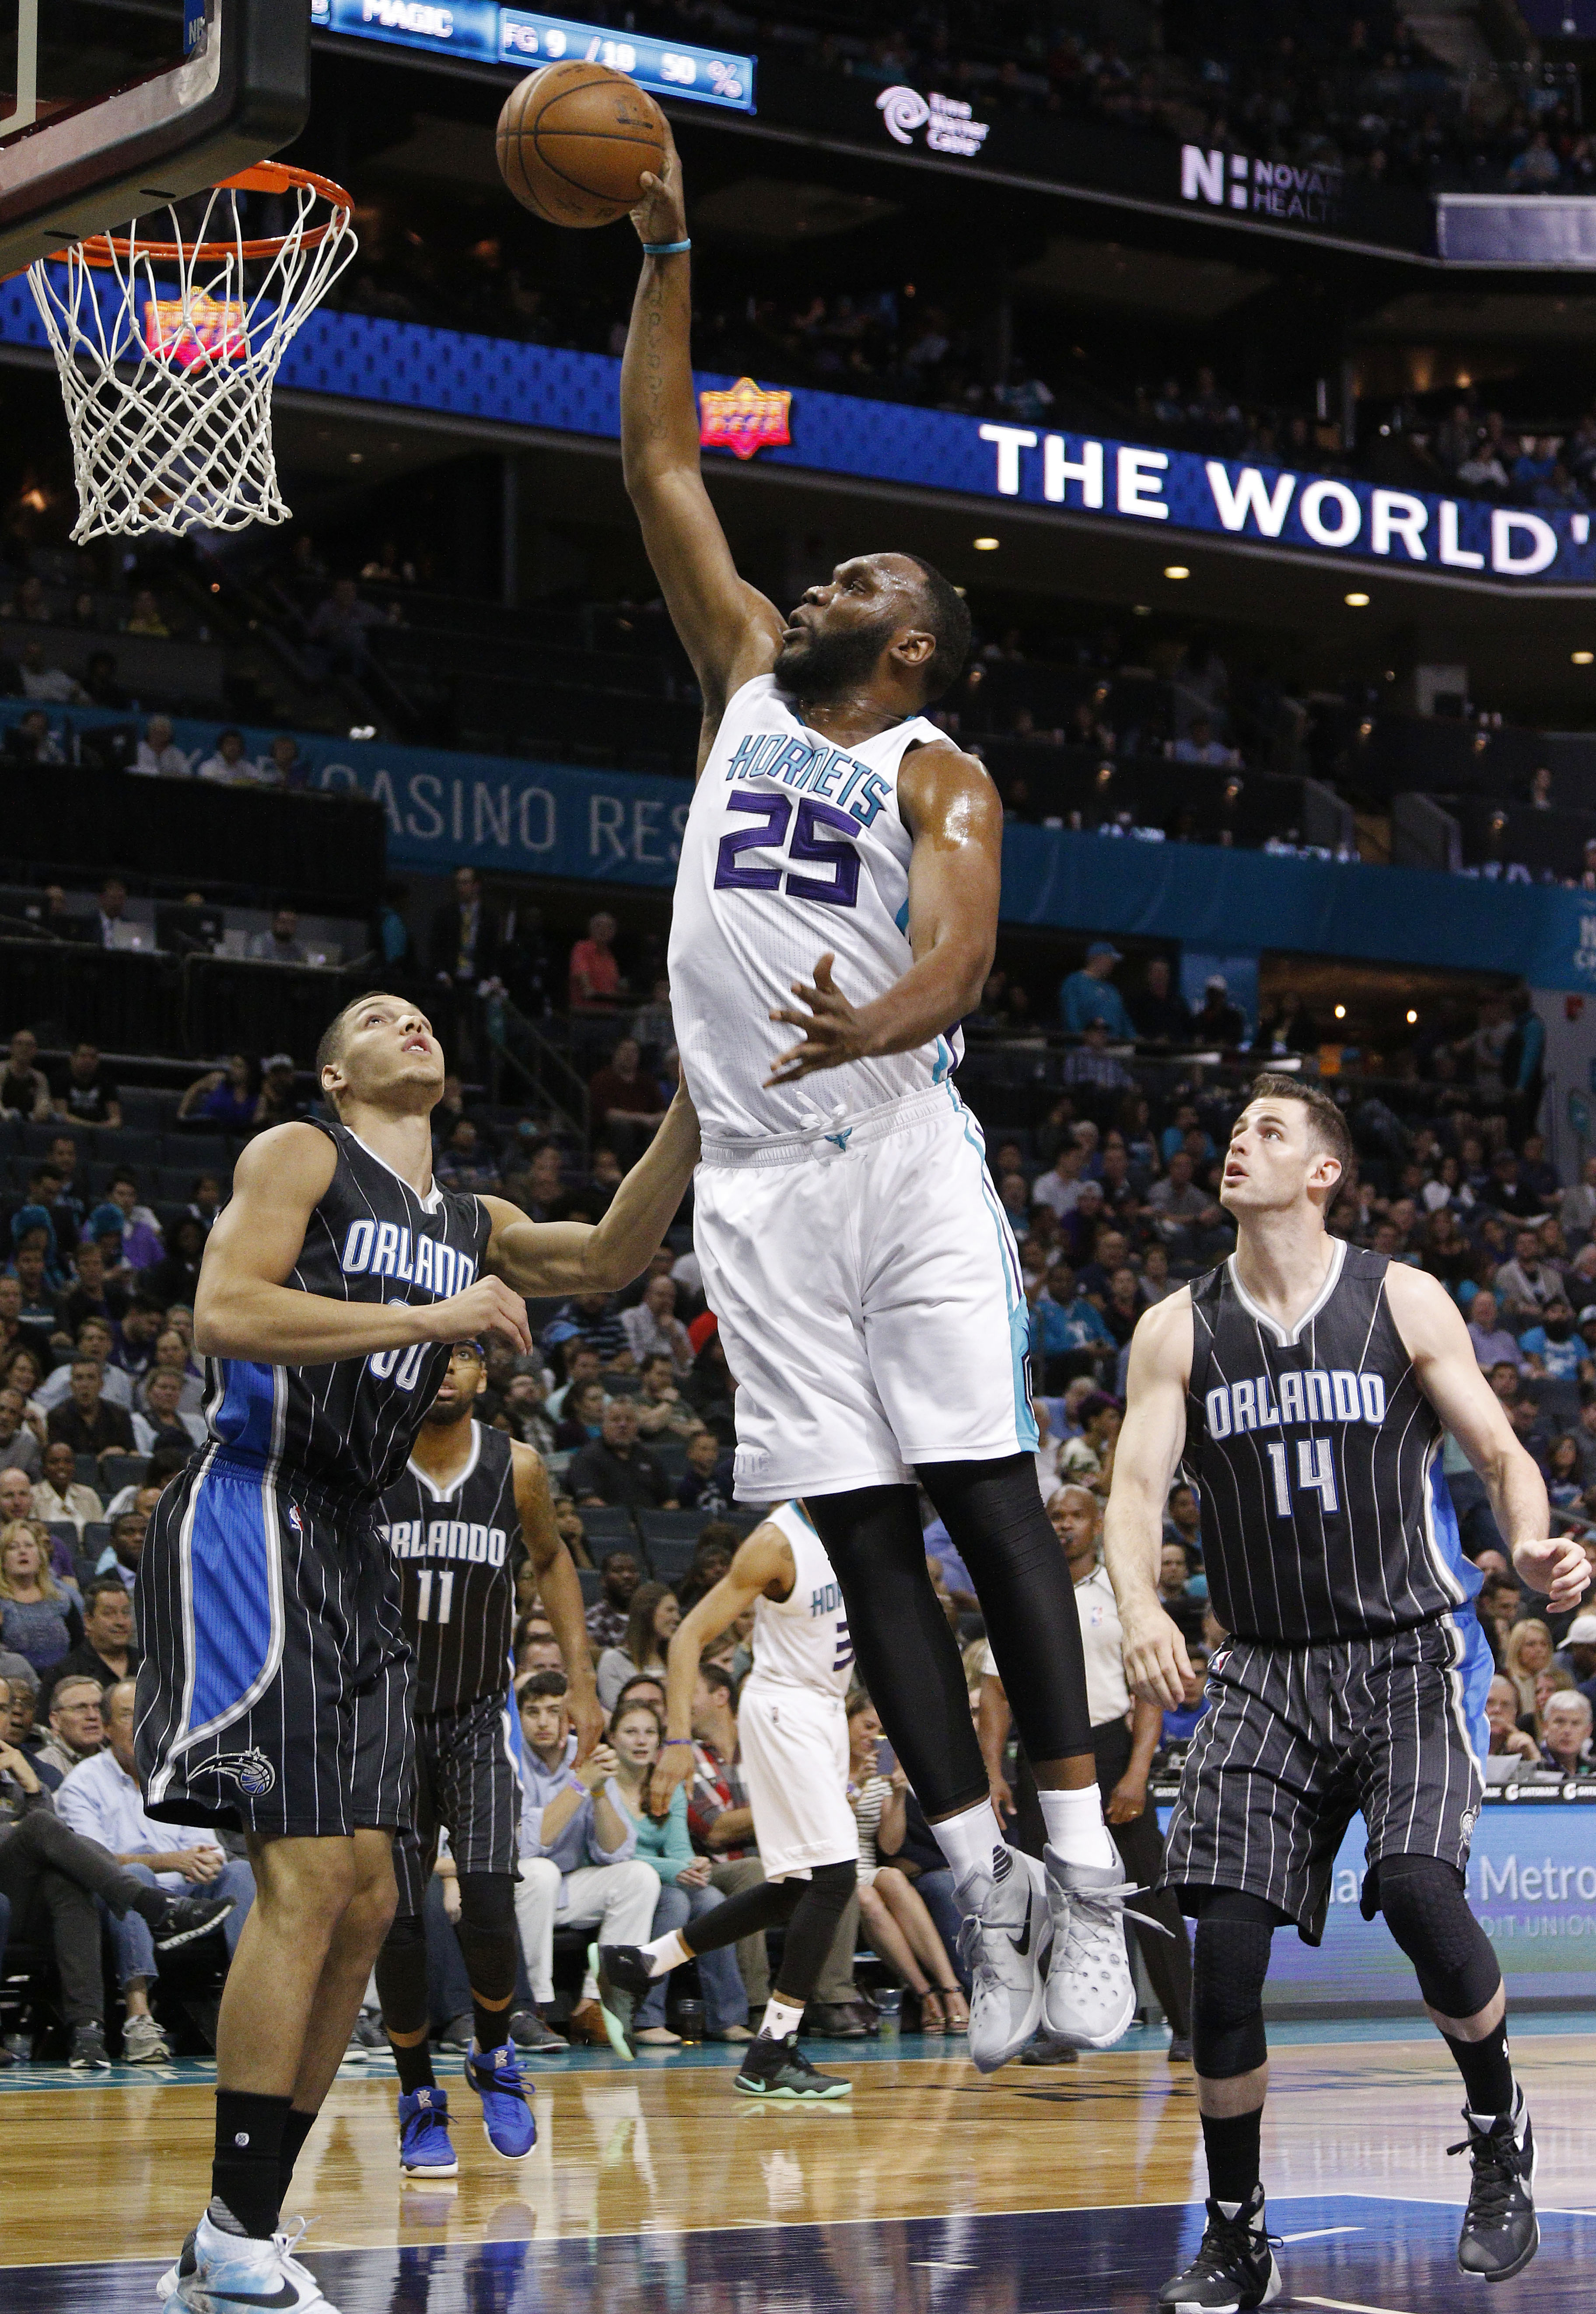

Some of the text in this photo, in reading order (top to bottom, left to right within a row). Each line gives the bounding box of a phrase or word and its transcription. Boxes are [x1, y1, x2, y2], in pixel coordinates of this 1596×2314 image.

[363, 0, 453, 38] MAGIC
[504, 23, 539, 53] FG
[546, 29, 567, 58] 9
[979, 423, 1169, 519] THE
[726, 734, 892, 828] HORNETS
[714, 789, 862, 908] 25
[340, 1219, 479, 1299] ORLAND
[1205, 1370, 1386, 1441] ORLANDO
[1267, 1437, 1340, 1518] 14
[417, 1570, 454, 1624] 11
[1480, 1854, 1596, 1901] Metro
